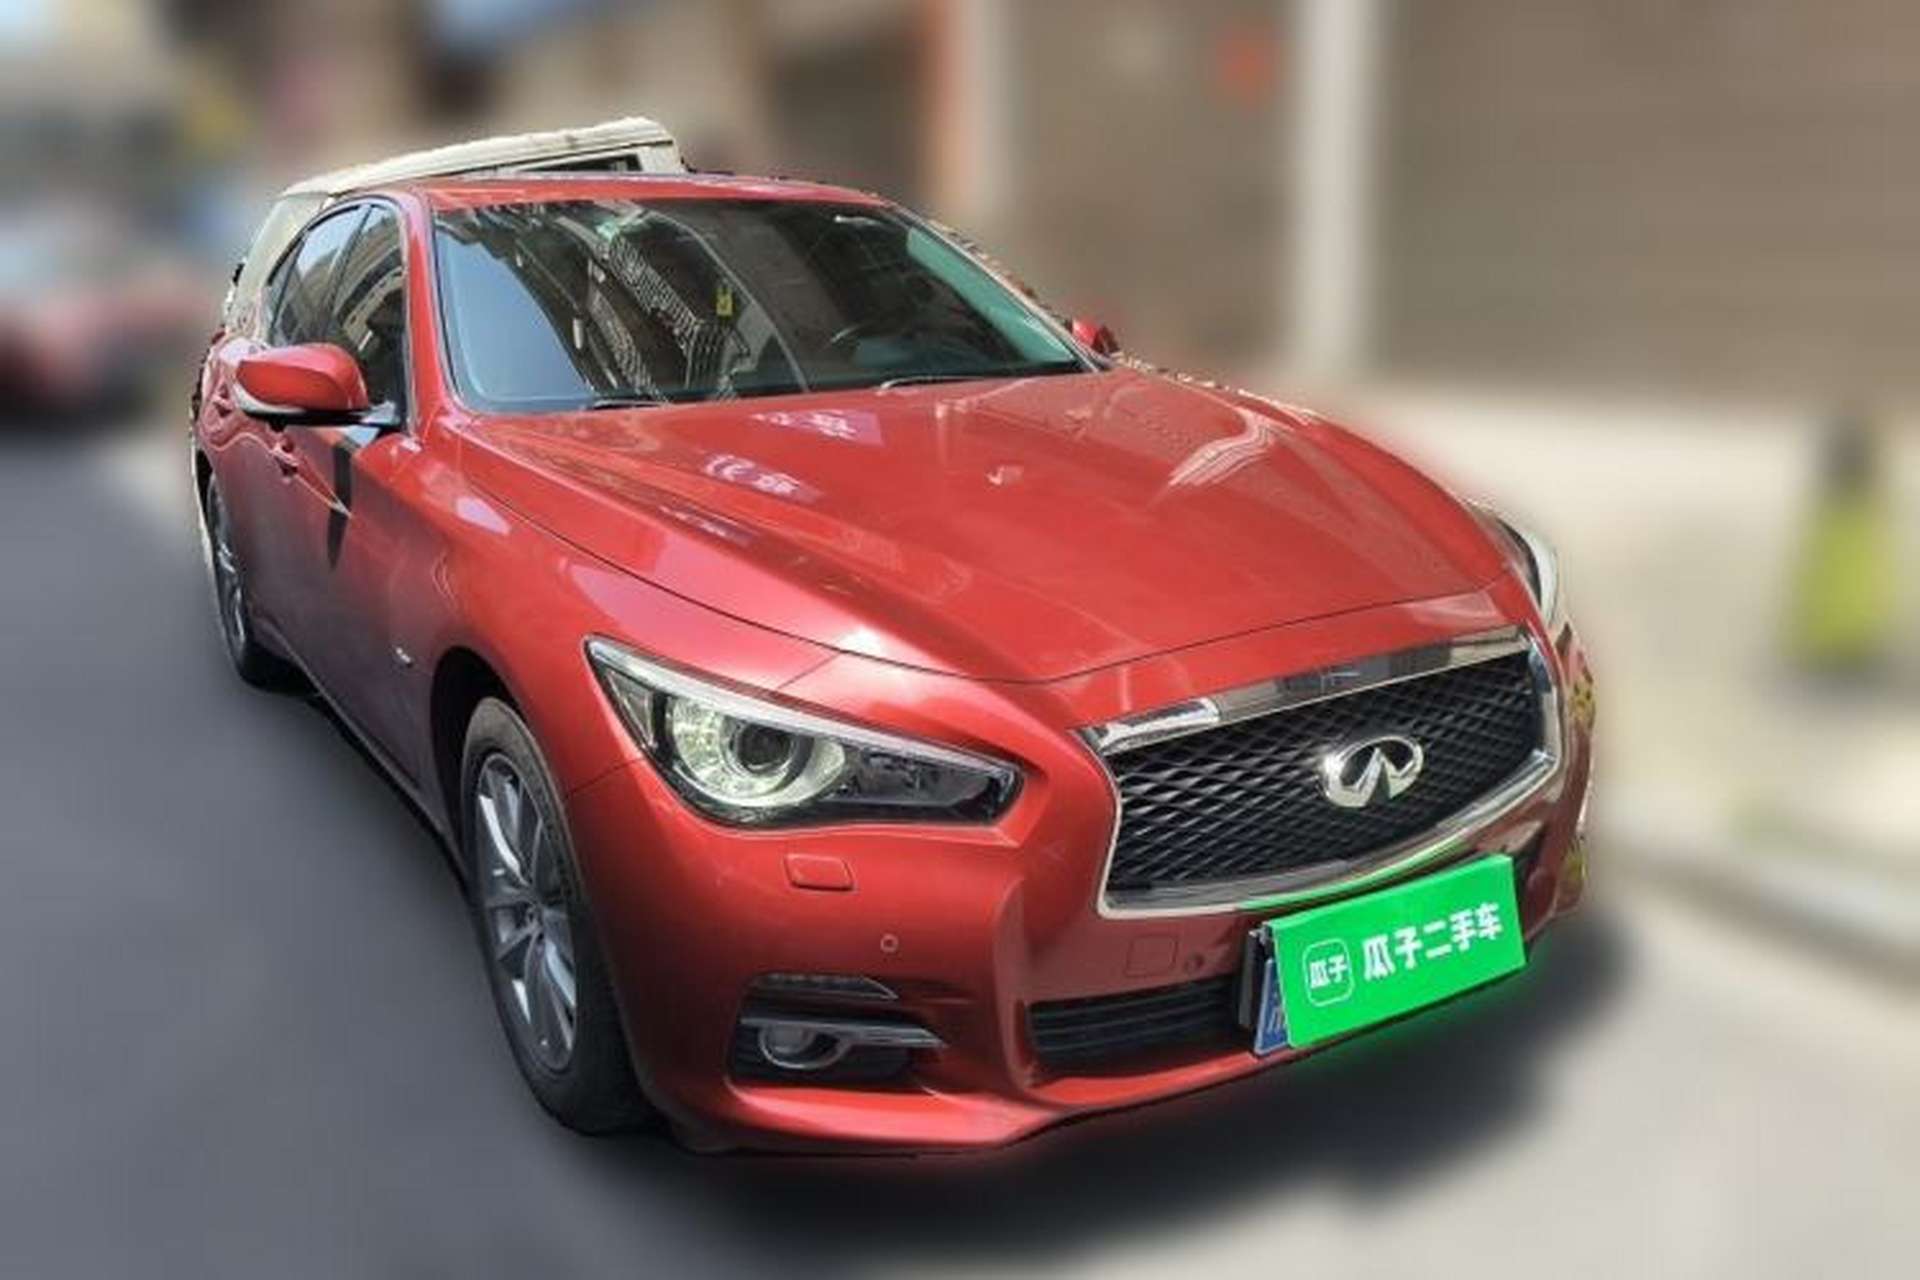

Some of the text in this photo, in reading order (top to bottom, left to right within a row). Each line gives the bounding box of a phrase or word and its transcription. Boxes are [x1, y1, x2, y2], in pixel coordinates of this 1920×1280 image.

[1362, 902, 1504, 981] 瓜子二手车
[1309, 954, 1348, 988] 瓜子
